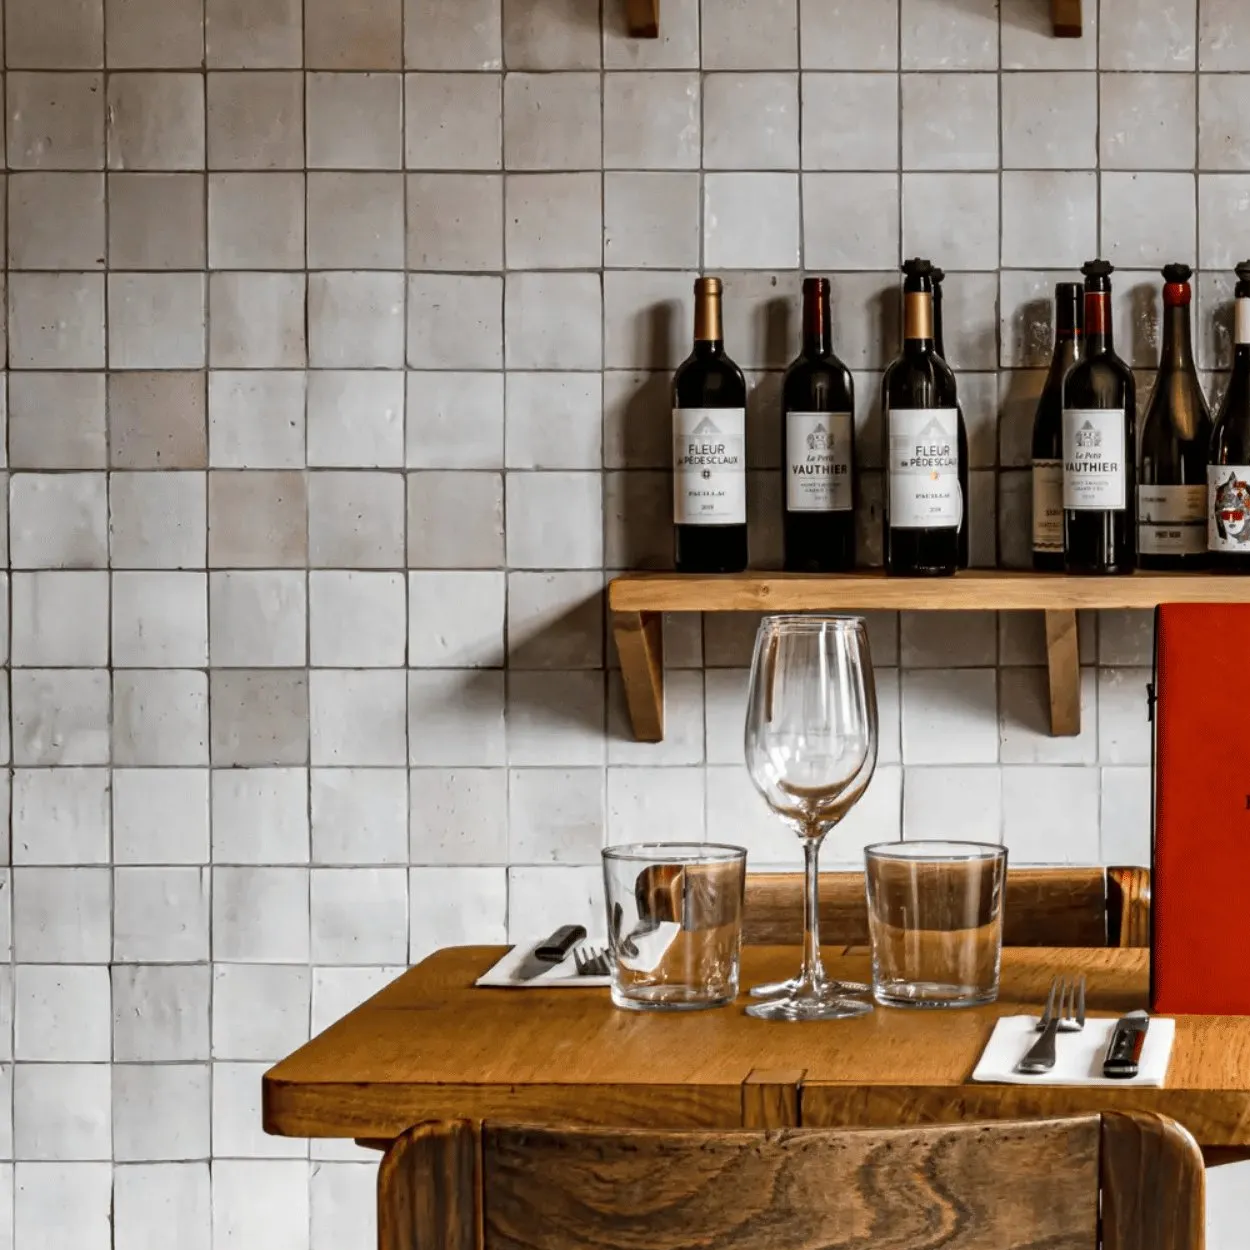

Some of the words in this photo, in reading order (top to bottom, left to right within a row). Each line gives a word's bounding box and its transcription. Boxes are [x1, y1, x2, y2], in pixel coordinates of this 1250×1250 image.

[688, 444, 725, 455] FLEUR
[915, 445, 950, 456] FLEUR
[684, 455, 738, 465] PÉDESCLAUX
[910, 456, 957, 467] PÉDESCLAU
[792, 464, 848, 475] VAUTHIER
[1065, 462, 1118, 472] VAUTHIER
